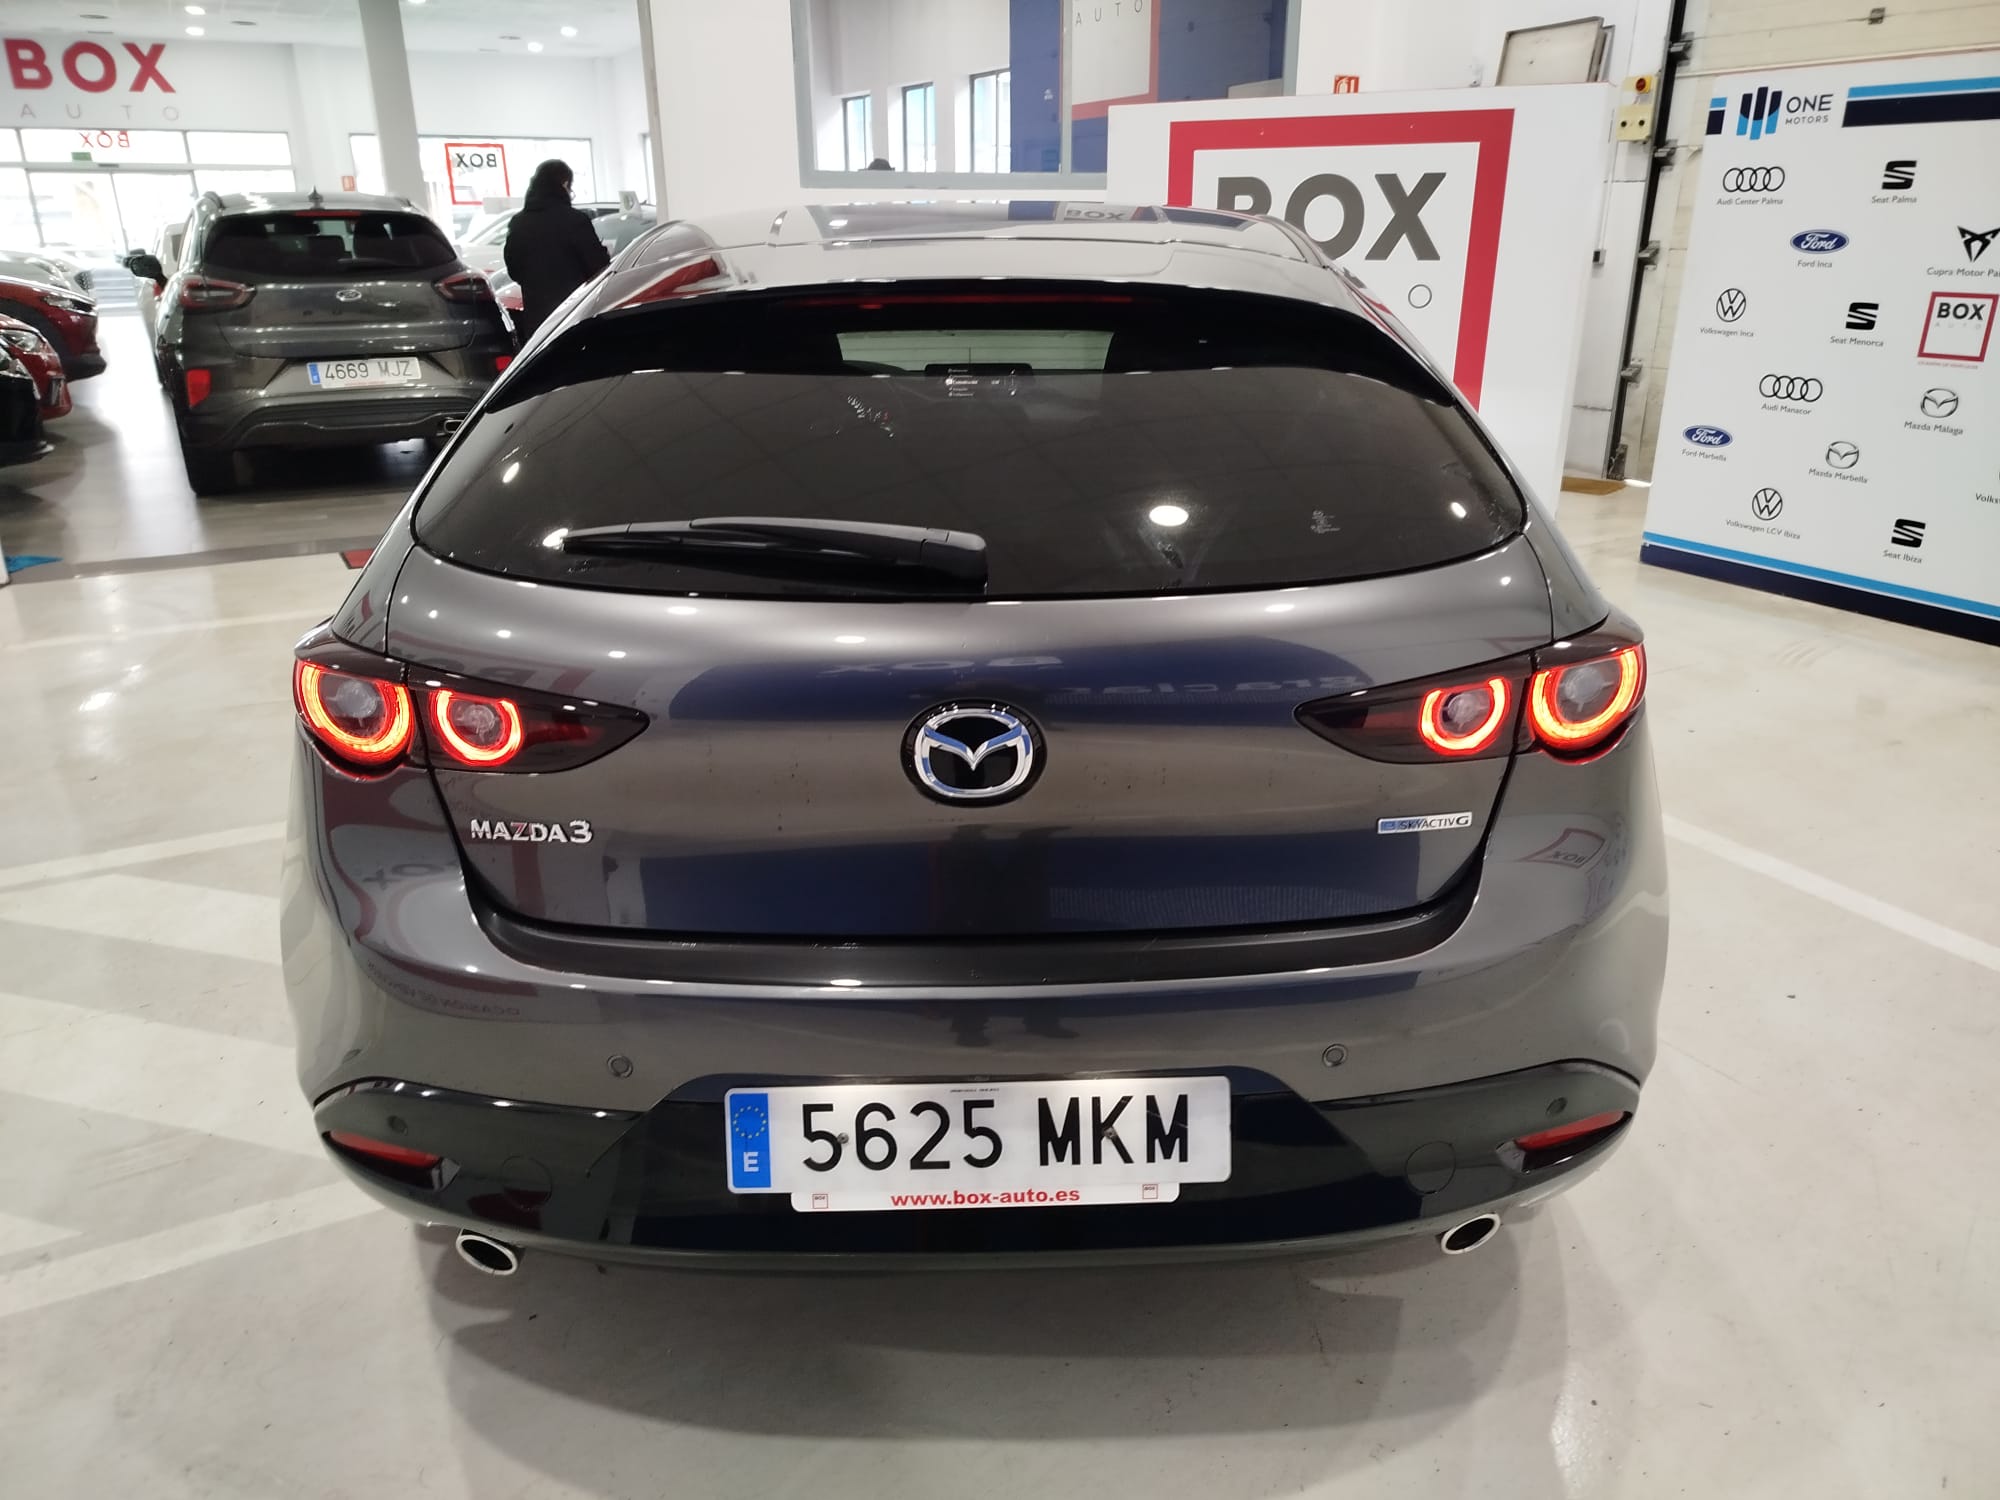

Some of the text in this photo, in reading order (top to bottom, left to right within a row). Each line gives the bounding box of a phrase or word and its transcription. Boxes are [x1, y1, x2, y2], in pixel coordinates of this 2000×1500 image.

[3, 38, 177, 93] BOX
[1786, 94, 1834, 113] ONE
[20, 103, 179, 121] AUTO
[1785, 115, 1829, 125] MOTORS
[1717, 197, 1784, 206] Audi Center Palma
[1871, 196, 1917, 204] Seat Palma
[1800, 232, 1839, 250] Ford
[1797, 260, 1833, 269] Ford Inca
[1926, 267, 1953, 277] Cupra
[1956, 268, 1984, 277] Motor
[1937, 302, 1986, 320] BOX
[1700, 327, 1738, 338] Volkswagen
[1830, 336, 1884, 347] Seat Menorca
[325, 360, 412, 379] 4669 MJZ
[1761, 403, 1811, 415] Audi Manacor
[1904, 421, 1931, 432] Mazda
[1691, 428, 1724, 445] Ford
[1682, 449, 1726, 461] Ford Marbella
[1808, 468, 1868, 484] Mazda Marbella
[1726, 519, 1765, 533] Volkswagen
[1784, 530, 1801, 540] Ibiza
[1883, 550, 1922, 564] Seat Ibiza
[802, 1094, 1188, 1172] 5625 MKM
[743, 1151, 760, 1173] E
[890, 1188, 1081, 1207] www.box-auto.es
